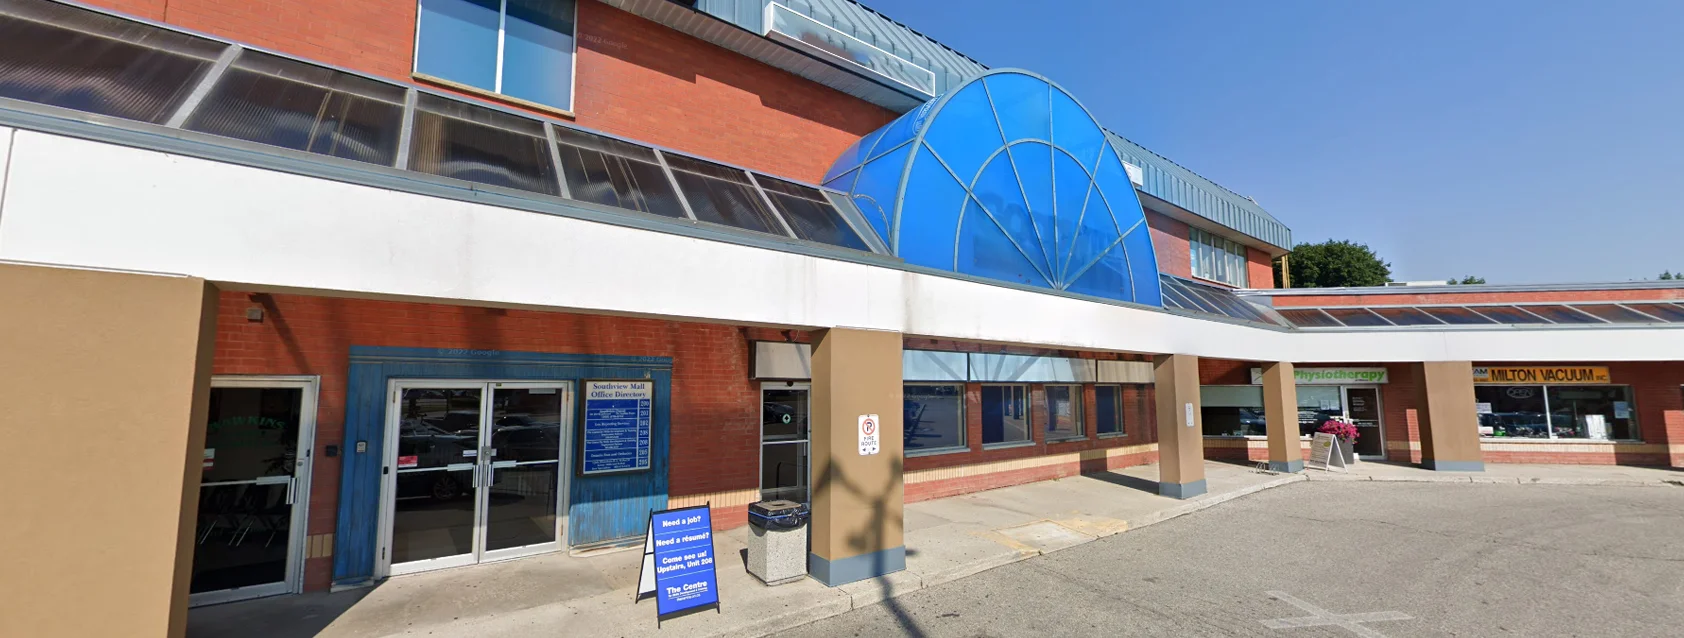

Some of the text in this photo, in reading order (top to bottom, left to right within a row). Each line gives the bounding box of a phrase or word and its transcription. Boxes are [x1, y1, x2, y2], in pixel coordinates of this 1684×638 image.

[1294, 369, 1385, 382] Physiotherapy
[1491, 369, 1537, 381] MILTON
[1540, 368, 1594, 381] VACUUM
[662, 518, 680, 527] Need
[687, 515, 701, 525] job?
[656, 537, 675, 547] Need
[682, 533, 709, 542] résumé?
[662, 550, 707, 564] Come see us!
[657, 557, 713, 574] Upstairs, Unit 208
[683, 581, 708, 591] Centre
